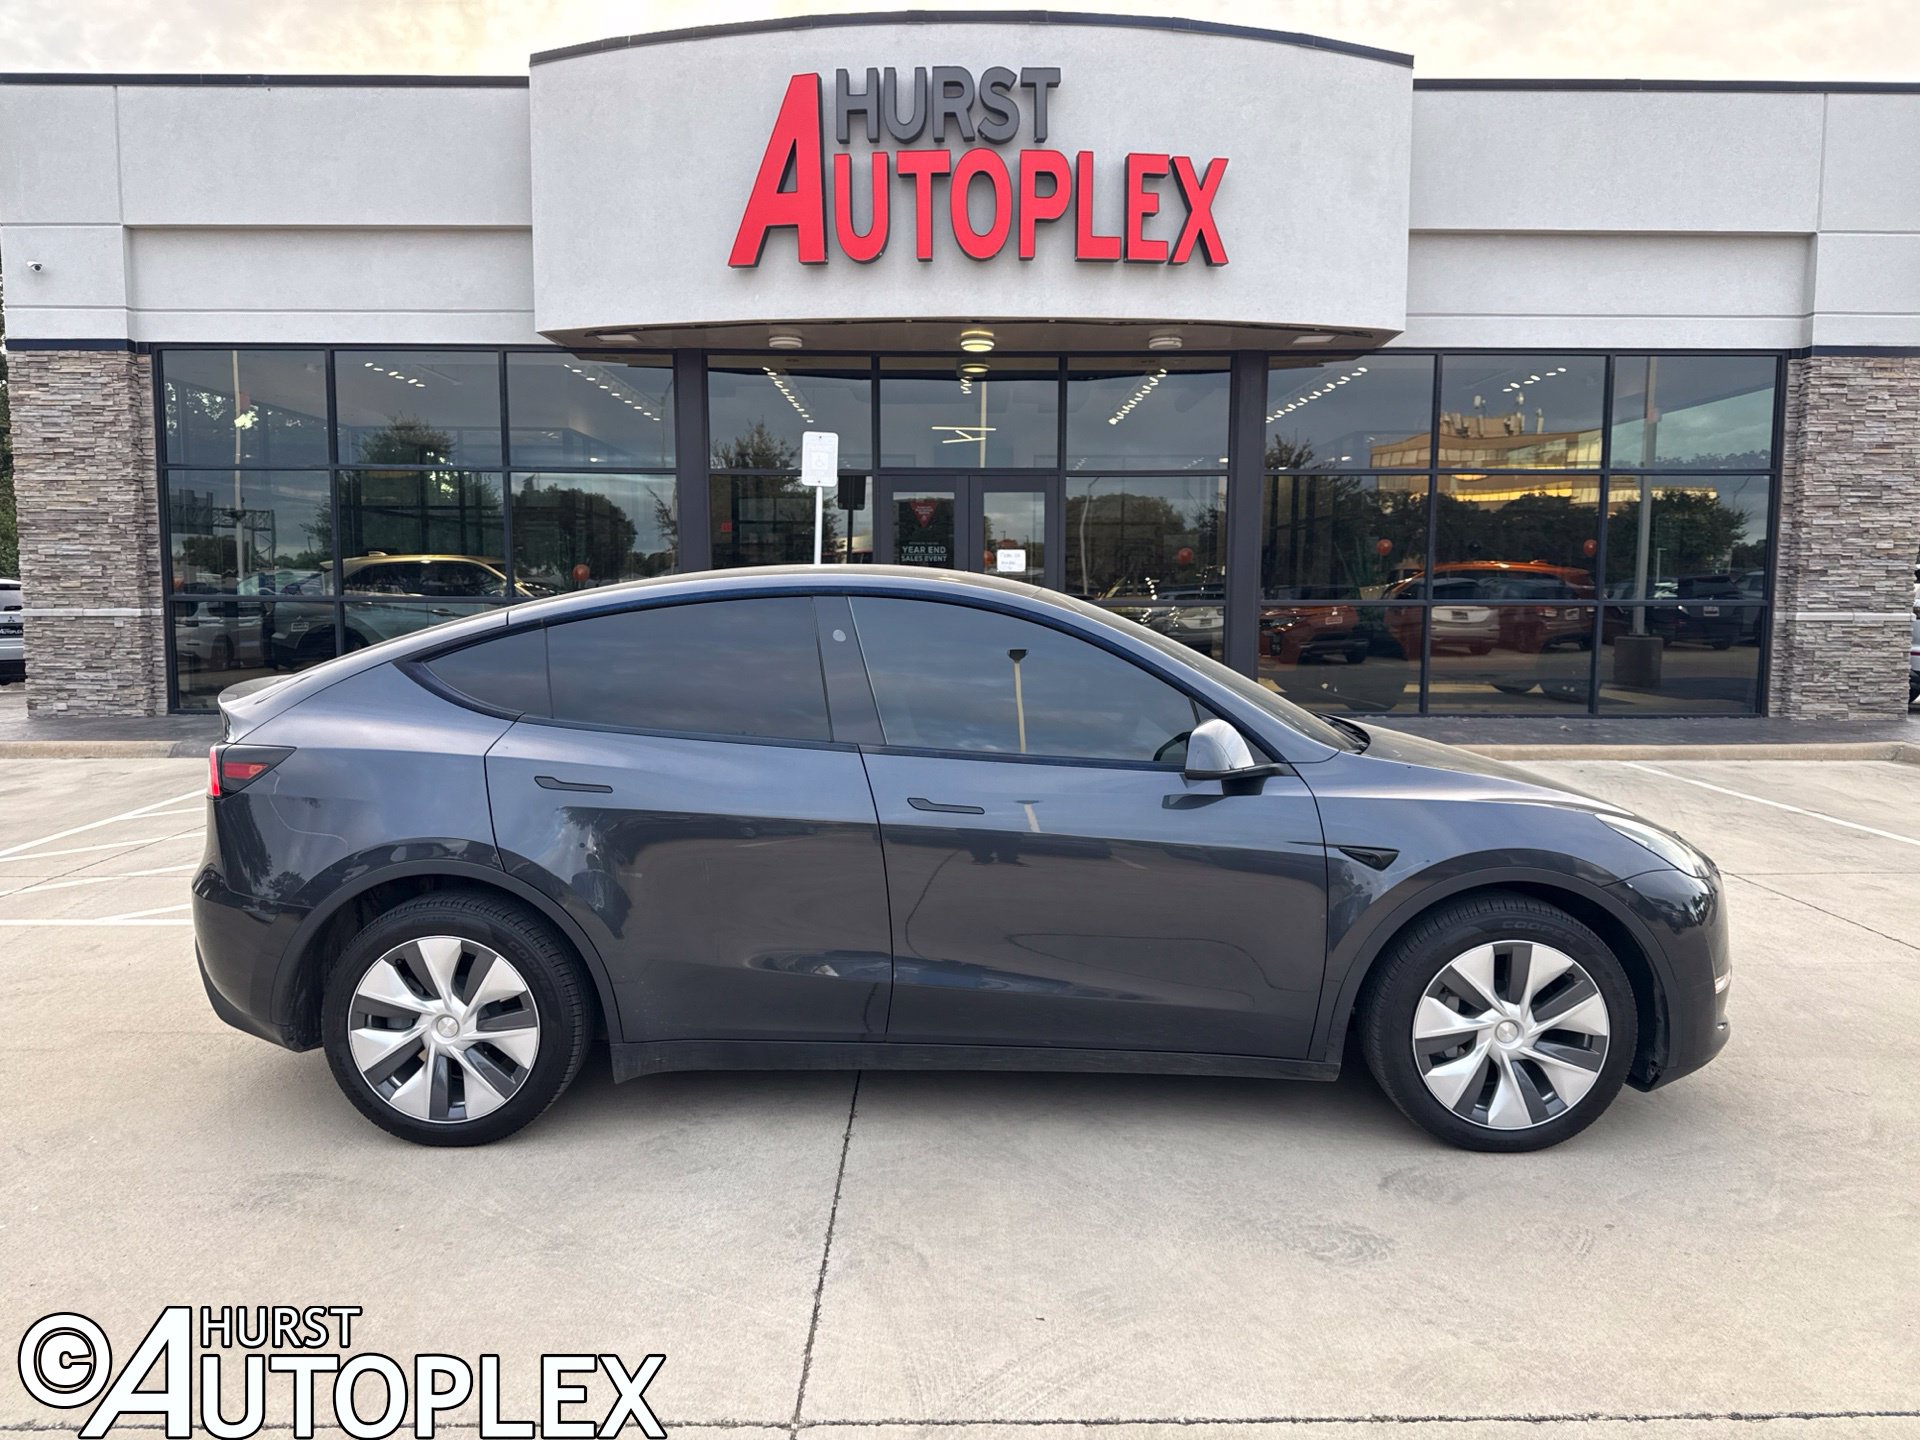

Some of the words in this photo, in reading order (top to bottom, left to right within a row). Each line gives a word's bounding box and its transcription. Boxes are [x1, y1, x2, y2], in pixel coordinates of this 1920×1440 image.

[835, 65, 1062, 145] HURST
[728, 72, 1230, 268] AUTOPLEX
[902, 545, 926, 554] YEAR
[927, 545, 947, 554] END
